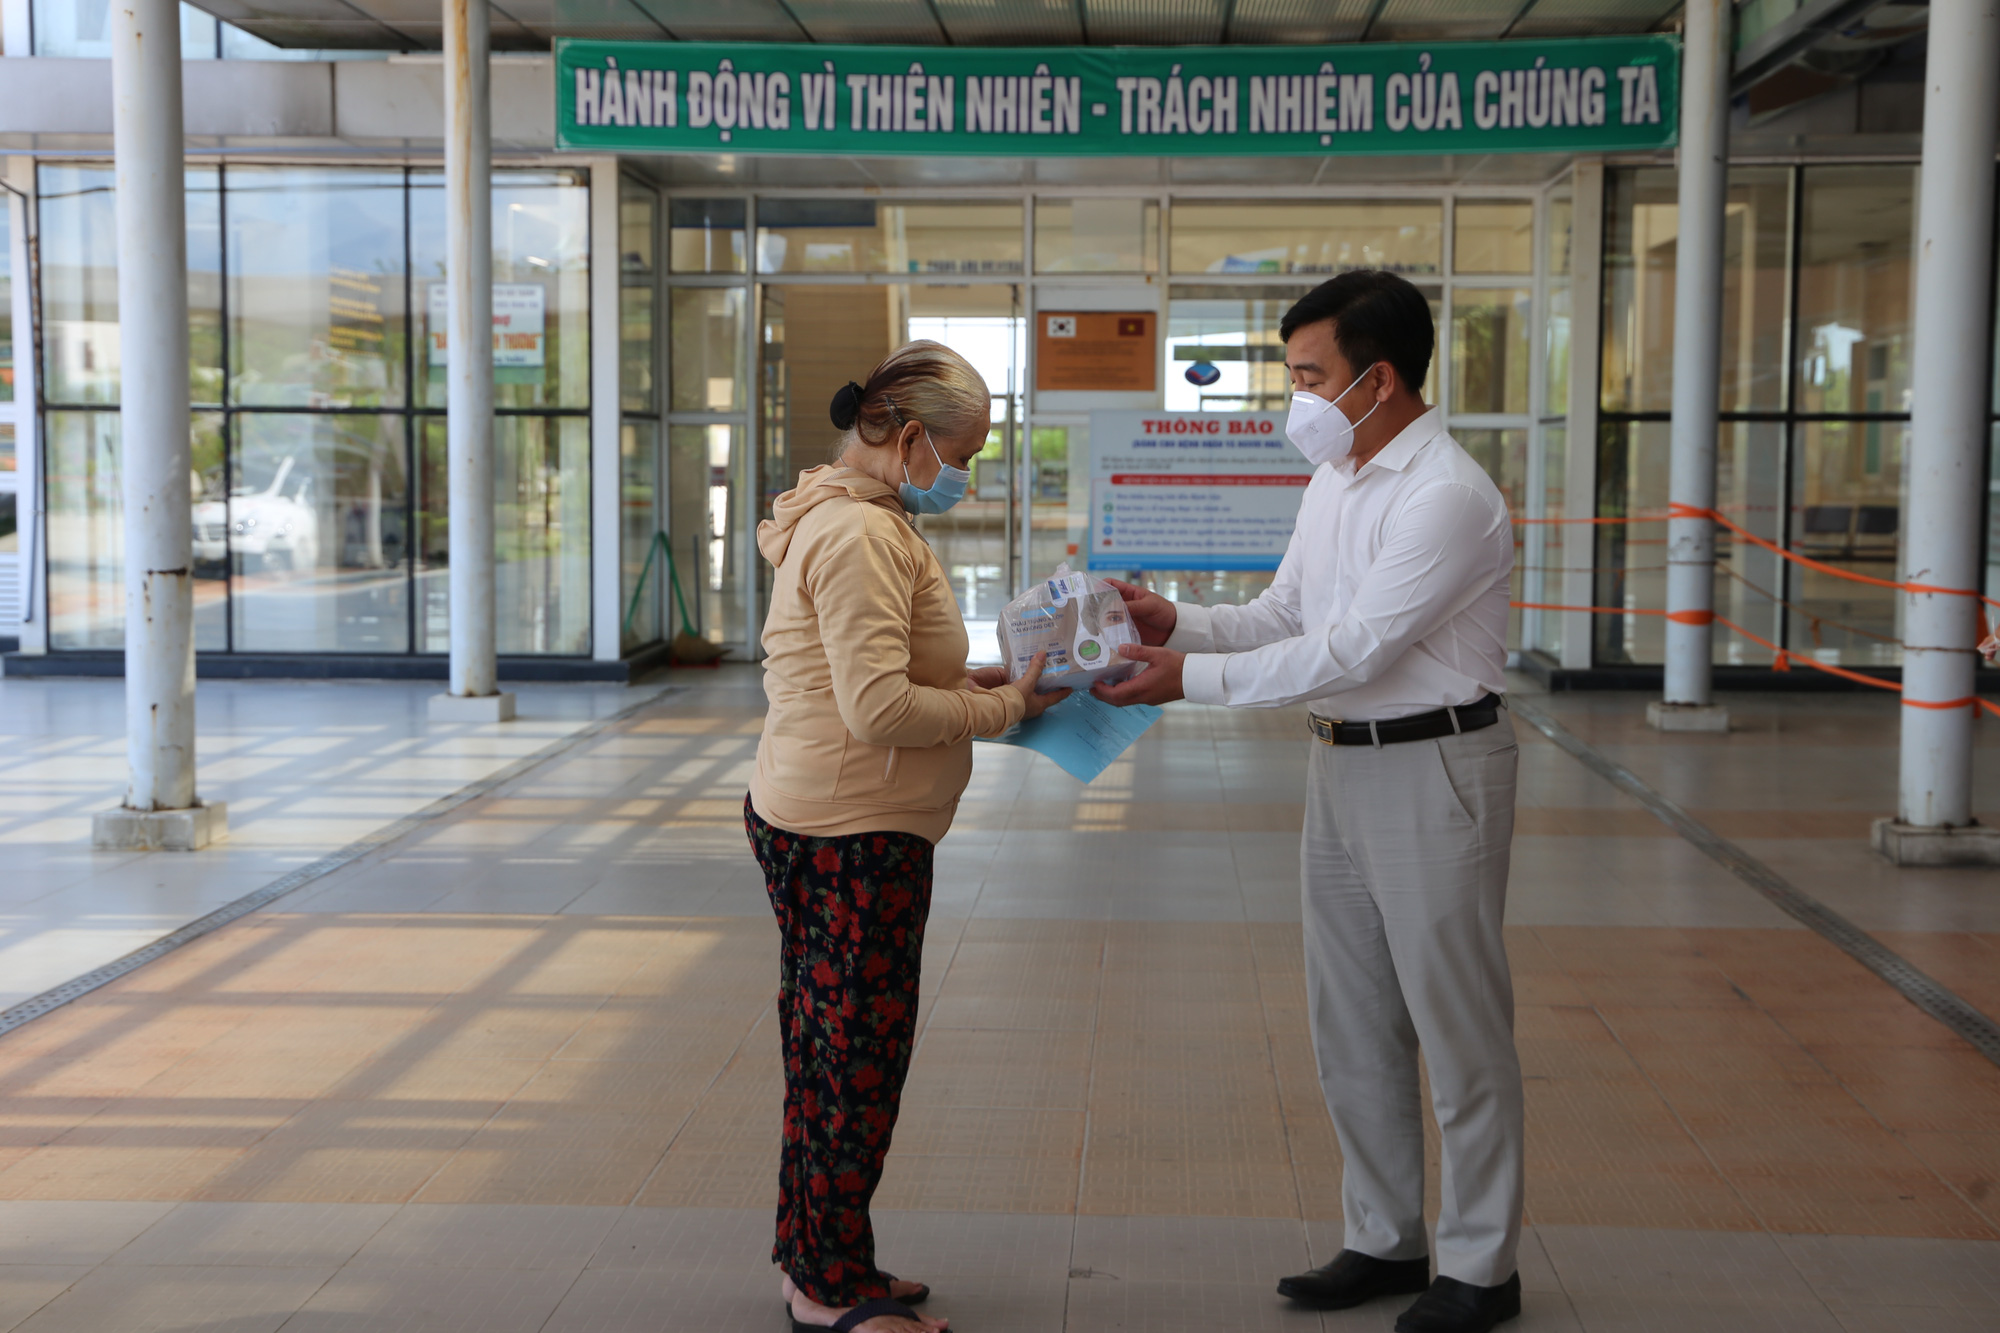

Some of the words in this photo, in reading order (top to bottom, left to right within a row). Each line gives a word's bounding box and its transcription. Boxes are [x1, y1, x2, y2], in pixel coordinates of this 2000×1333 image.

[575, 56, 678, 127] HÀNH
[687, 58, 791, 142] ĐỘNG
[801, 60, 836, 131] VÌ
[846, 62, 955, 133] THIÊN
[965, 63, 1083, 134] NHIÊN
[1091, 103, 1107, 117] -
[1116, 63, 1238, 135] TRÁCH
[1248, 62, 1374, 147] NHIỆM
[1385, 52, 1463, 132] CỦA
[1473, 56, 1606, 130] CHÚNG
[1617, 65, 1661, 125] TA
[1141, 416, 1220, 435] THÔNG
[1227, 416, 1274, 435] BÁO
